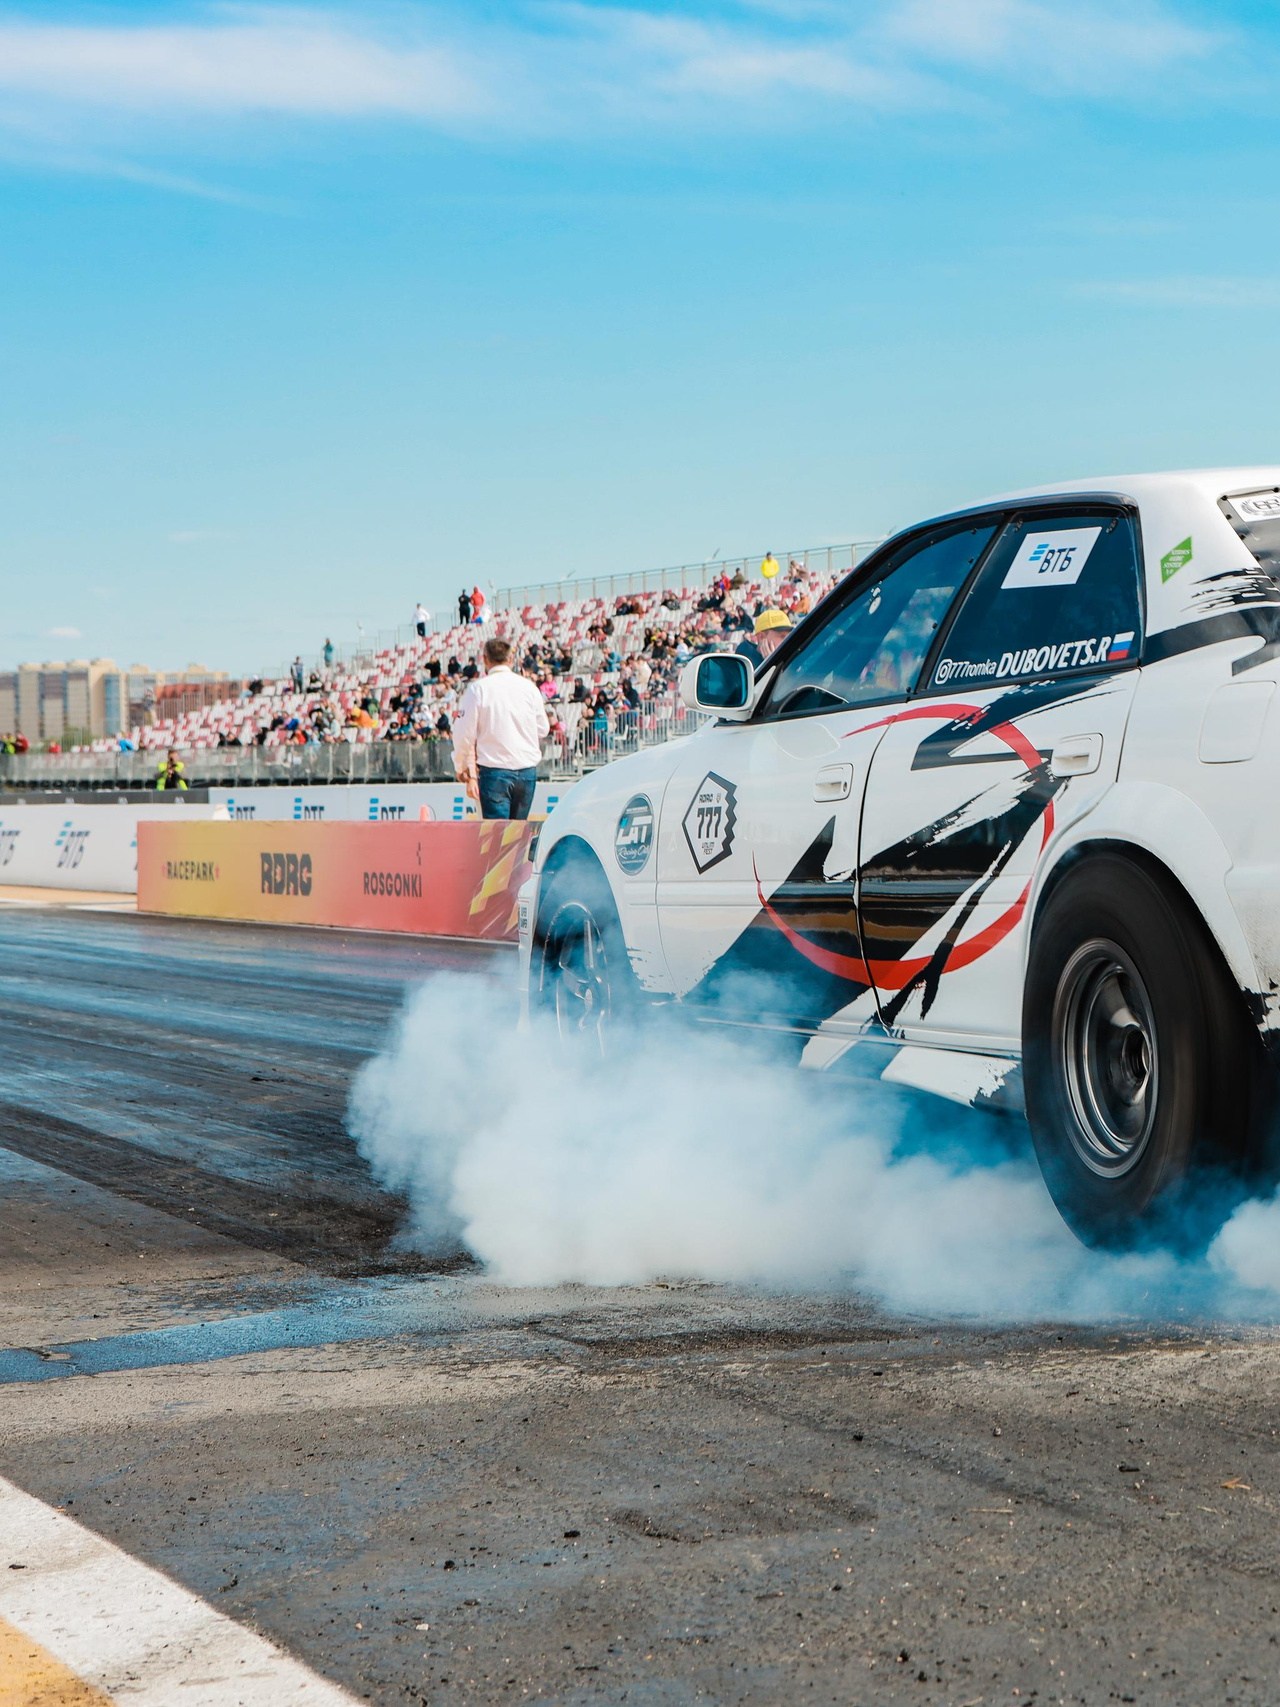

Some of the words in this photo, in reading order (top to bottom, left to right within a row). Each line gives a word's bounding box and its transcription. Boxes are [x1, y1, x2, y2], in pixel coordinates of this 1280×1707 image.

[1038, 547, 1077, 574] ВТБ
[996, 636, 1111, 678] DUBOVETS.R
[697, 806, 722, 839] 777
[166, 861, 215, 882] RACEPARK
[260, 852, 312, 896] RDRC
[363, 872, 422, 898] ROSGONKI
